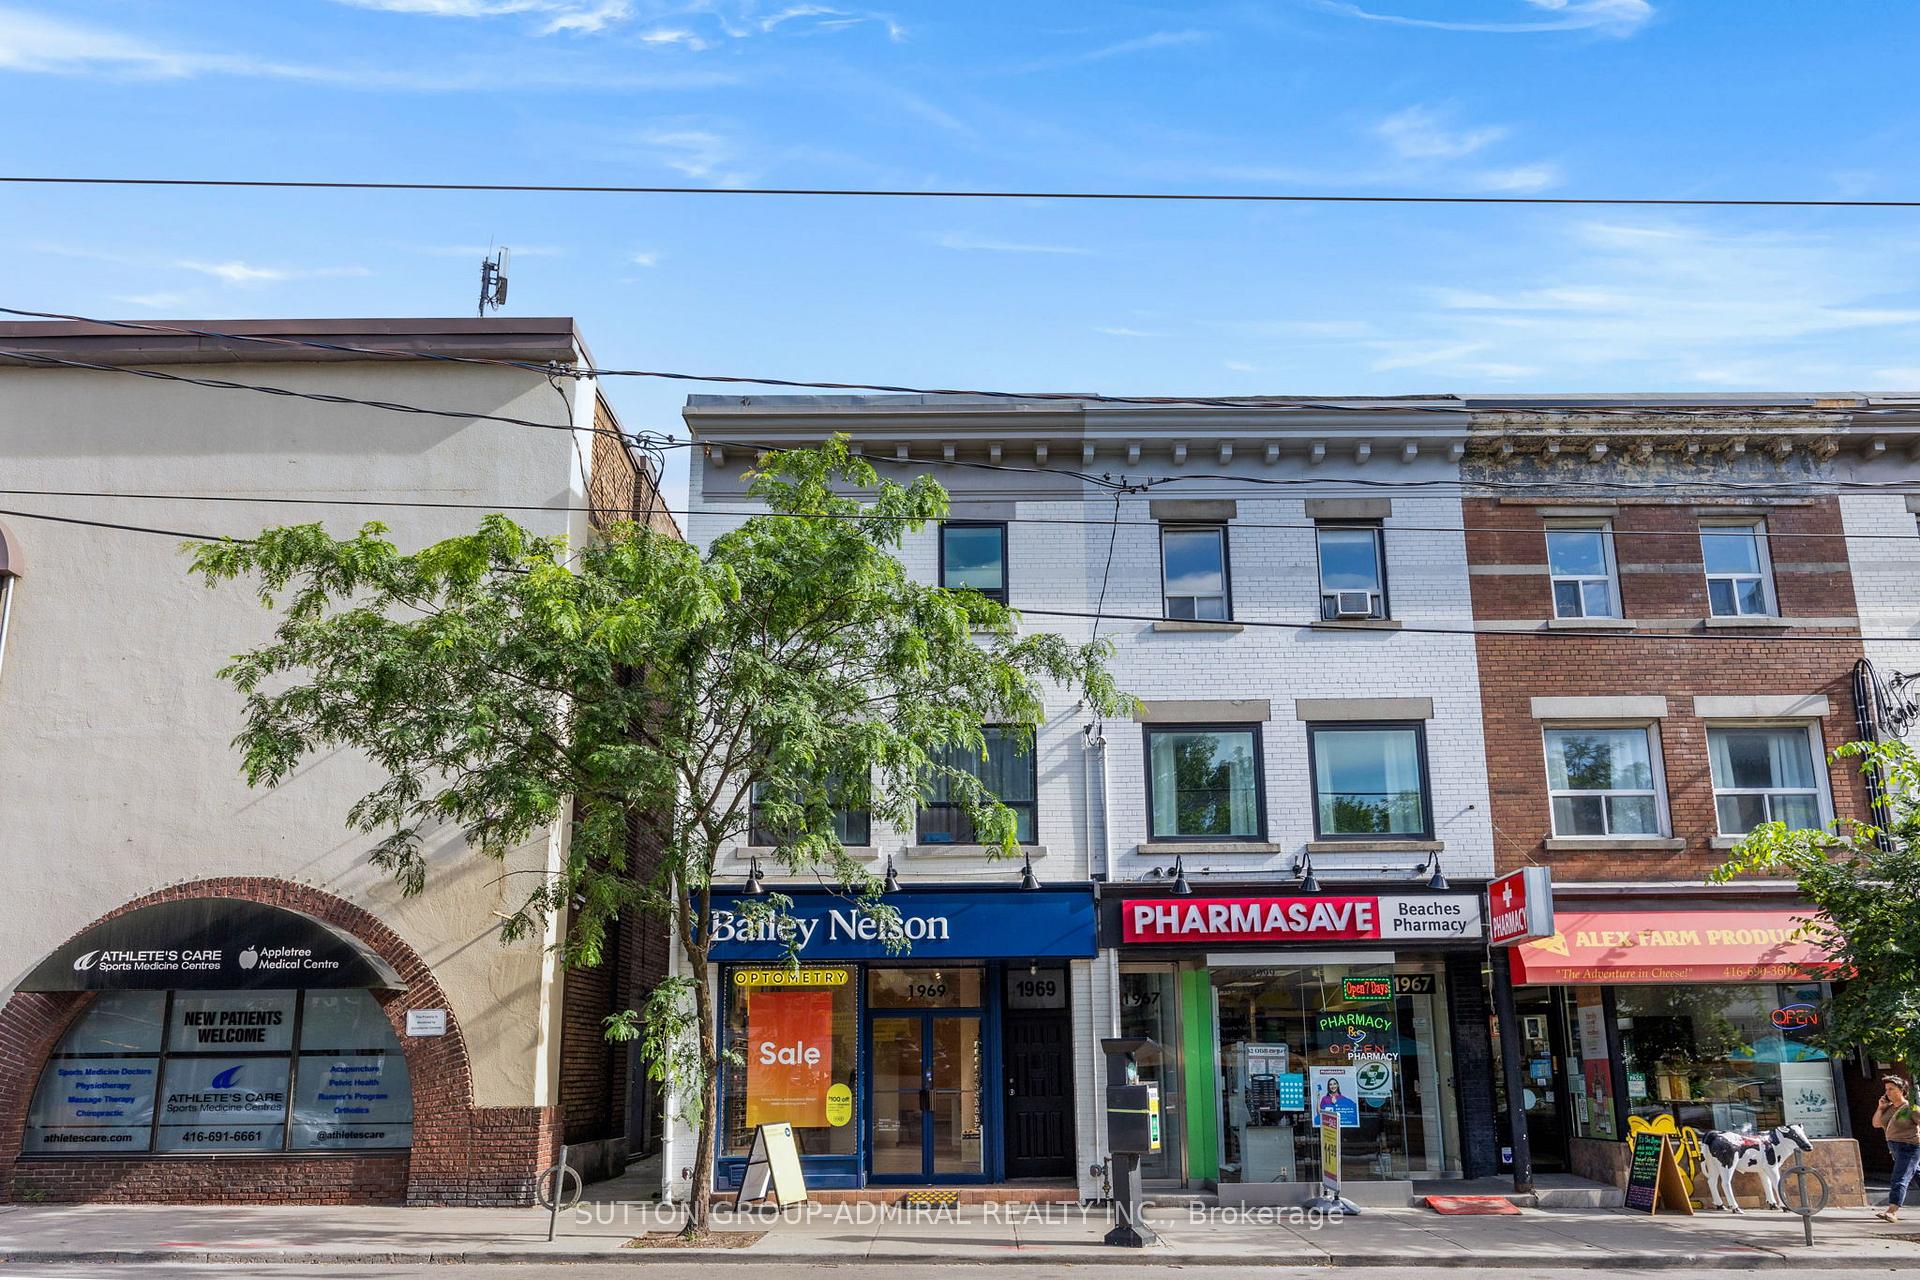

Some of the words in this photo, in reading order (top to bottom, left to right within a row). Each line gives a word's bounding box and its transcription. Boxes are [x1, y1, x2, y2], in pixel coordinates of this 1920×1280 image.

[1399, 902, 1461, 917] Beaches
[1133, 902, 1374, 934] PHARMASAVE
[1492, 907, 1528, 939] PHARMACY
[709, 910, 819, 949] Bailey
[829, 909, 950, 941] Nelson
[1393, 918, 1467, 934] Pharmacy
[1575, 930, 1634, 947] ALEX
[1636, 929, 1702, 946] FARM
[100, 950, 178, 961] ATHLETE'S
[181, 950, 222, 960] CARE
[260, 946, 312, 958] Appletree
[99, 961, 132, 972] Sports
[134, 961, 179, 970] Medicine
[181, 961, 221, 970] Centres
[258, 959, 301, 970] Medical
[304, 960, 340, 969] Centre
[1583, 968, 1636, 979] Adventure
[1639, 969, 1649, 978] in
[1723, 965, 1798, 977] 416-690-3600
[735, 972, 847, 984] OPTOMETRY
[908, 984, 946, 997] 1969
[1016, 981, 1056, 997] 1969
[1346, 982, 1364, 998] Open
[1371, 981, 1390, 994] Days
[1394, 977, 1431, 992] 1967
[1123, 993, 1160, 1004] 1967
[184, 1012, 216, 1026] NEW
[220, 1011, 282, 1025] PATIENTS
[1320, 1013, 1392, 1031] PHARMACY
[1771, 1009, 1818, 1025] OPEN
[198, 1028, 265, 1043] WELCOME
[760, 1040, 820, 1065] Sale
[1329, 1043, 1385, 1055] OPEN
[1347, 1052, 1399, 1061] PHARMACY
[58, 1068, 83, 1077] Sports
[85, 1068, 119, 1076] Medicine
[121, 1068, 152, 1076] Doctors
[330, 1065, 380, 1074] Acupuncture
[75, 1082, 132, 1091] Physiotherapy
[329, 1079, 353, 1087] Pelvic
[354, 1079, 379, 1087] Health
[68, 1096, 103, 1105] Massage
[104, 1095, 136, 1105] Therapy
[168, 1093, 240, 1103] ATHLETE'S
[245, 1092, 283, 1102] CARE
[354, 1093, 388, 1102] Program
[76, 1109, 124, 1118] Chiropractic
[167, 1103, 198, 1113] Sports
[201, 1103, 242, 1112] Medicine
[244, 1102, 282, 1111] Centres
[333, 1106, 370, 1114] Orthotics
[43, 1133, 133, 1144] athletescare.com
[182, 1130, 262, 1142] 416-691-6661
[317, 1130, 385, 1142] @athletescare
